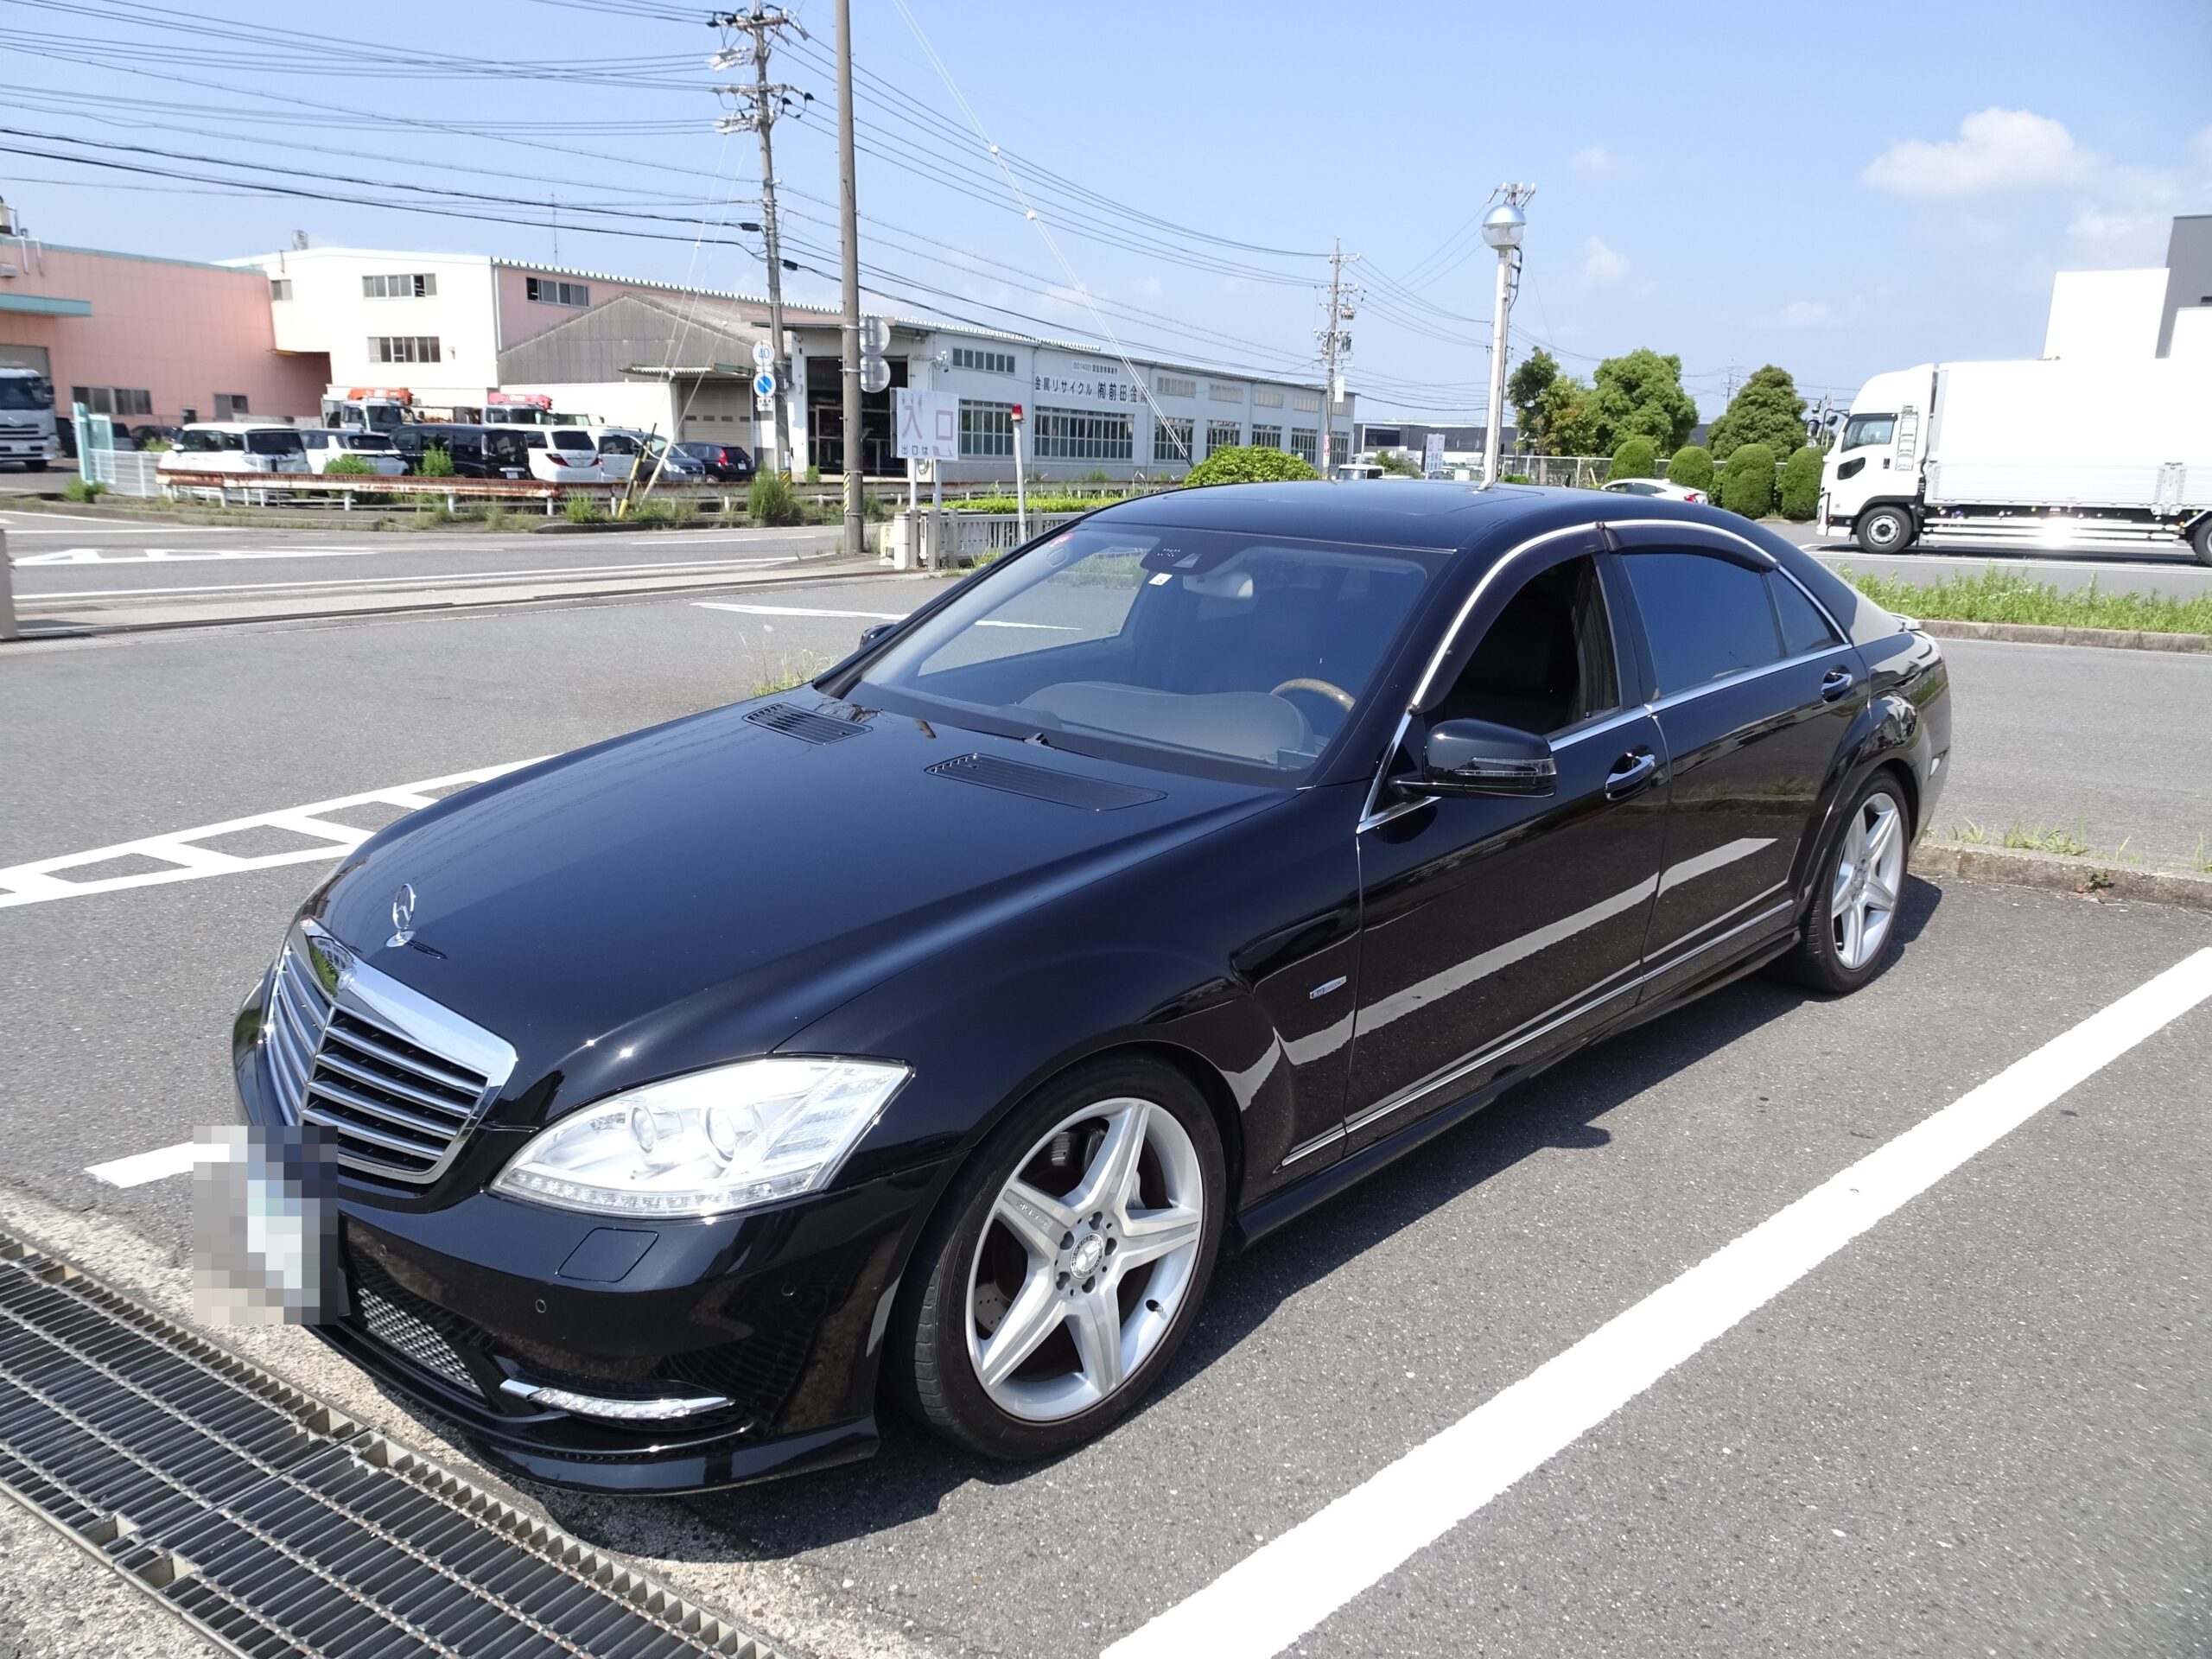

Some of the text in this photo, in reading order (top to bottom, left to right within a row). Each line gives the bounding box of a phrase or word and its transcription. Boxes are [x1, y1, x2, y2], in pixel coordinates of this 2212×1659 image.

[758, 347, 770, 359] 40
[1034, 376, 1093, 396] 金属リサイクル
[901, 404, 954, 442] 入口
[901, 444, 929, 456] 出口は
